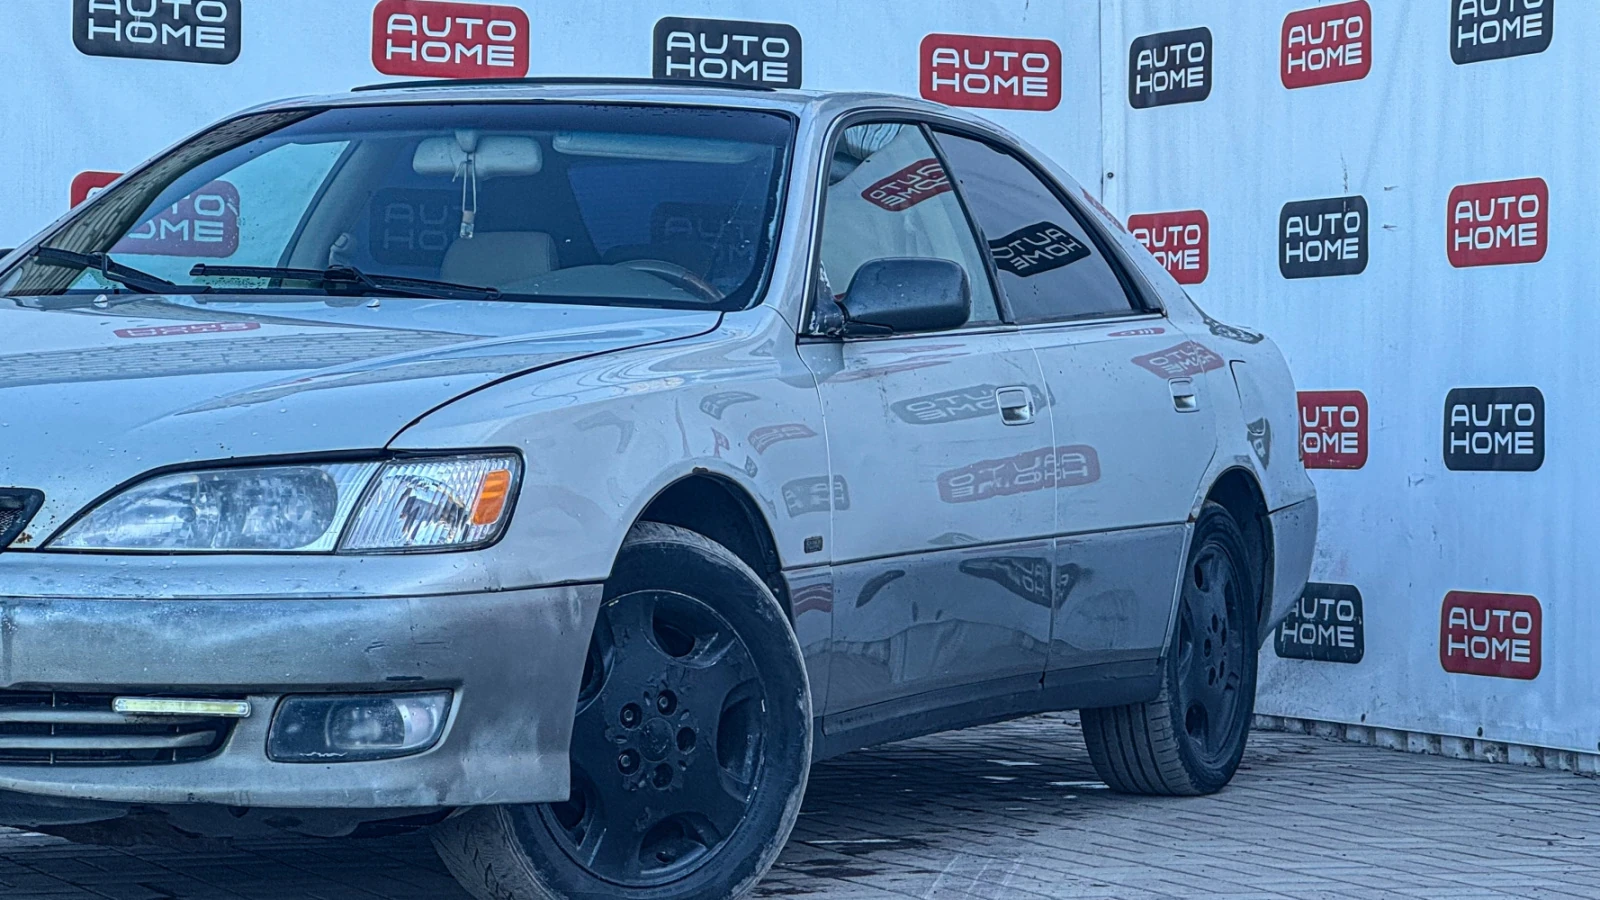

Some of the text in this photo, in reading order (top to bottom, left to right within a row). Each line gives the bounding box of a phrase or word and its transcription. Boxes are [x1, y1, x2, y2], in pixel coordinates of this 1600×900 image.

[88, 0, 227, 22] AUTO
[87, 18, 226, 49] HOME
[387, 14, 516, 42] AUTO
[1288, 16, 1364, 48] AUTO
[1457, 13, 1543, 48] HOME
[385, 38, 515, 67] HOME
[666, 32, 790, 58] AUTO
[1137, 42, 1205, 70] AUTO
[1287, 42, 1363, 73] HOME
[665, 56, 788, 83] HOME
[932, 48, 1050, 73] AUTO
[932, 72, 1048, 97] HOME
[1136, 65, 1204, 94] HOME
[1454, 195, 1540, 224] AUTO
[128, 219, 224, 243] OME
[1285, 212, 1361, 239] AUTO
[1454, 223, 1538, 252] HOME
[1152, 249, 1200, 271] OME
[1285, 238, 1359, 264] HOME
[1302, 405, 1360, 428] UTO
[1450, 403, 1535, 427] AUTO
[1303, 431, 1359, 454] OME
[1450, 431, 1534, 455] HOME
[1449, 606, 1533, 635] AUTO
[1280, 621, 1355, 648] HOME
[1447, 633, 1531, 663] HOME
